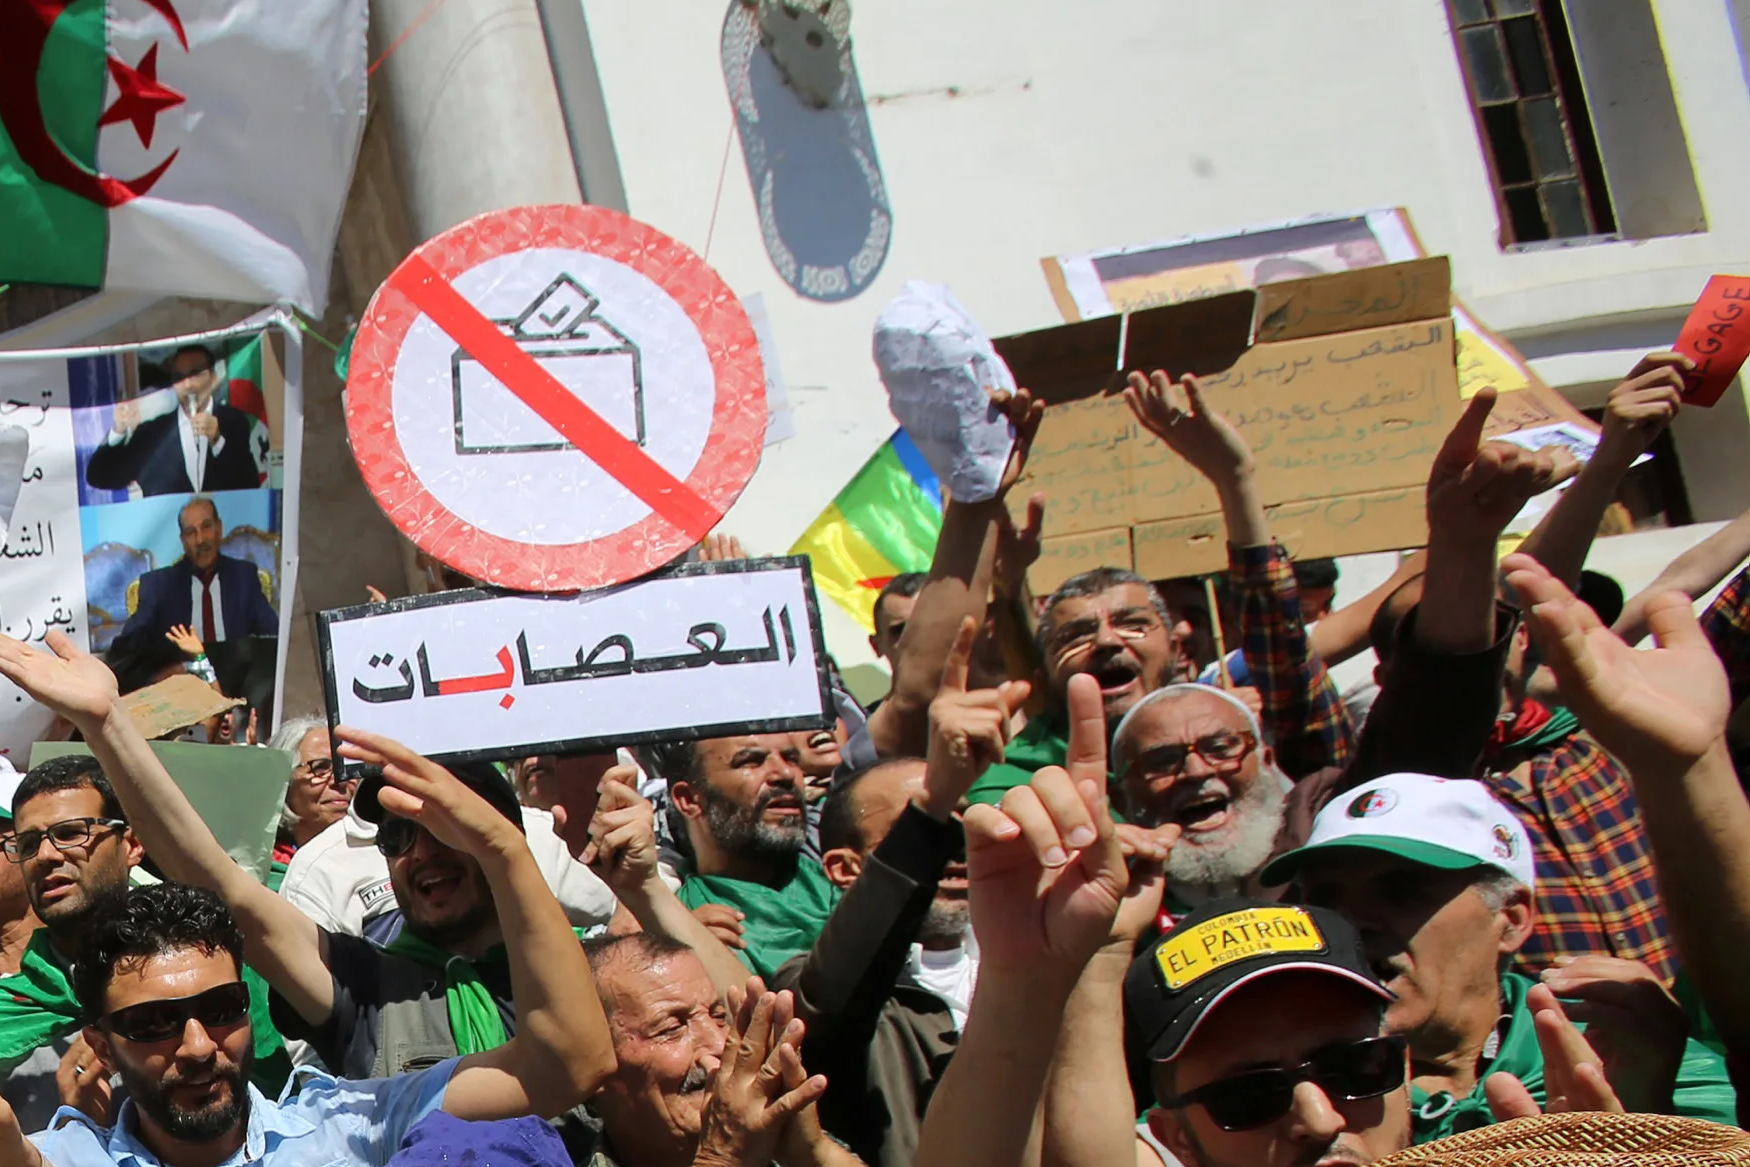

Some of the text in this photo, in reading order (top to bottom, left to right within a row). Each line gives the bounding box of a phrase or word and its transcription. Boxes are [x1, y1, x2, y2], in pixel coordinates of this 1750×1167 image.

[352, 605, 796, 711] العصابات
[1168, 916, 1310, 974] EL PATRÓN
